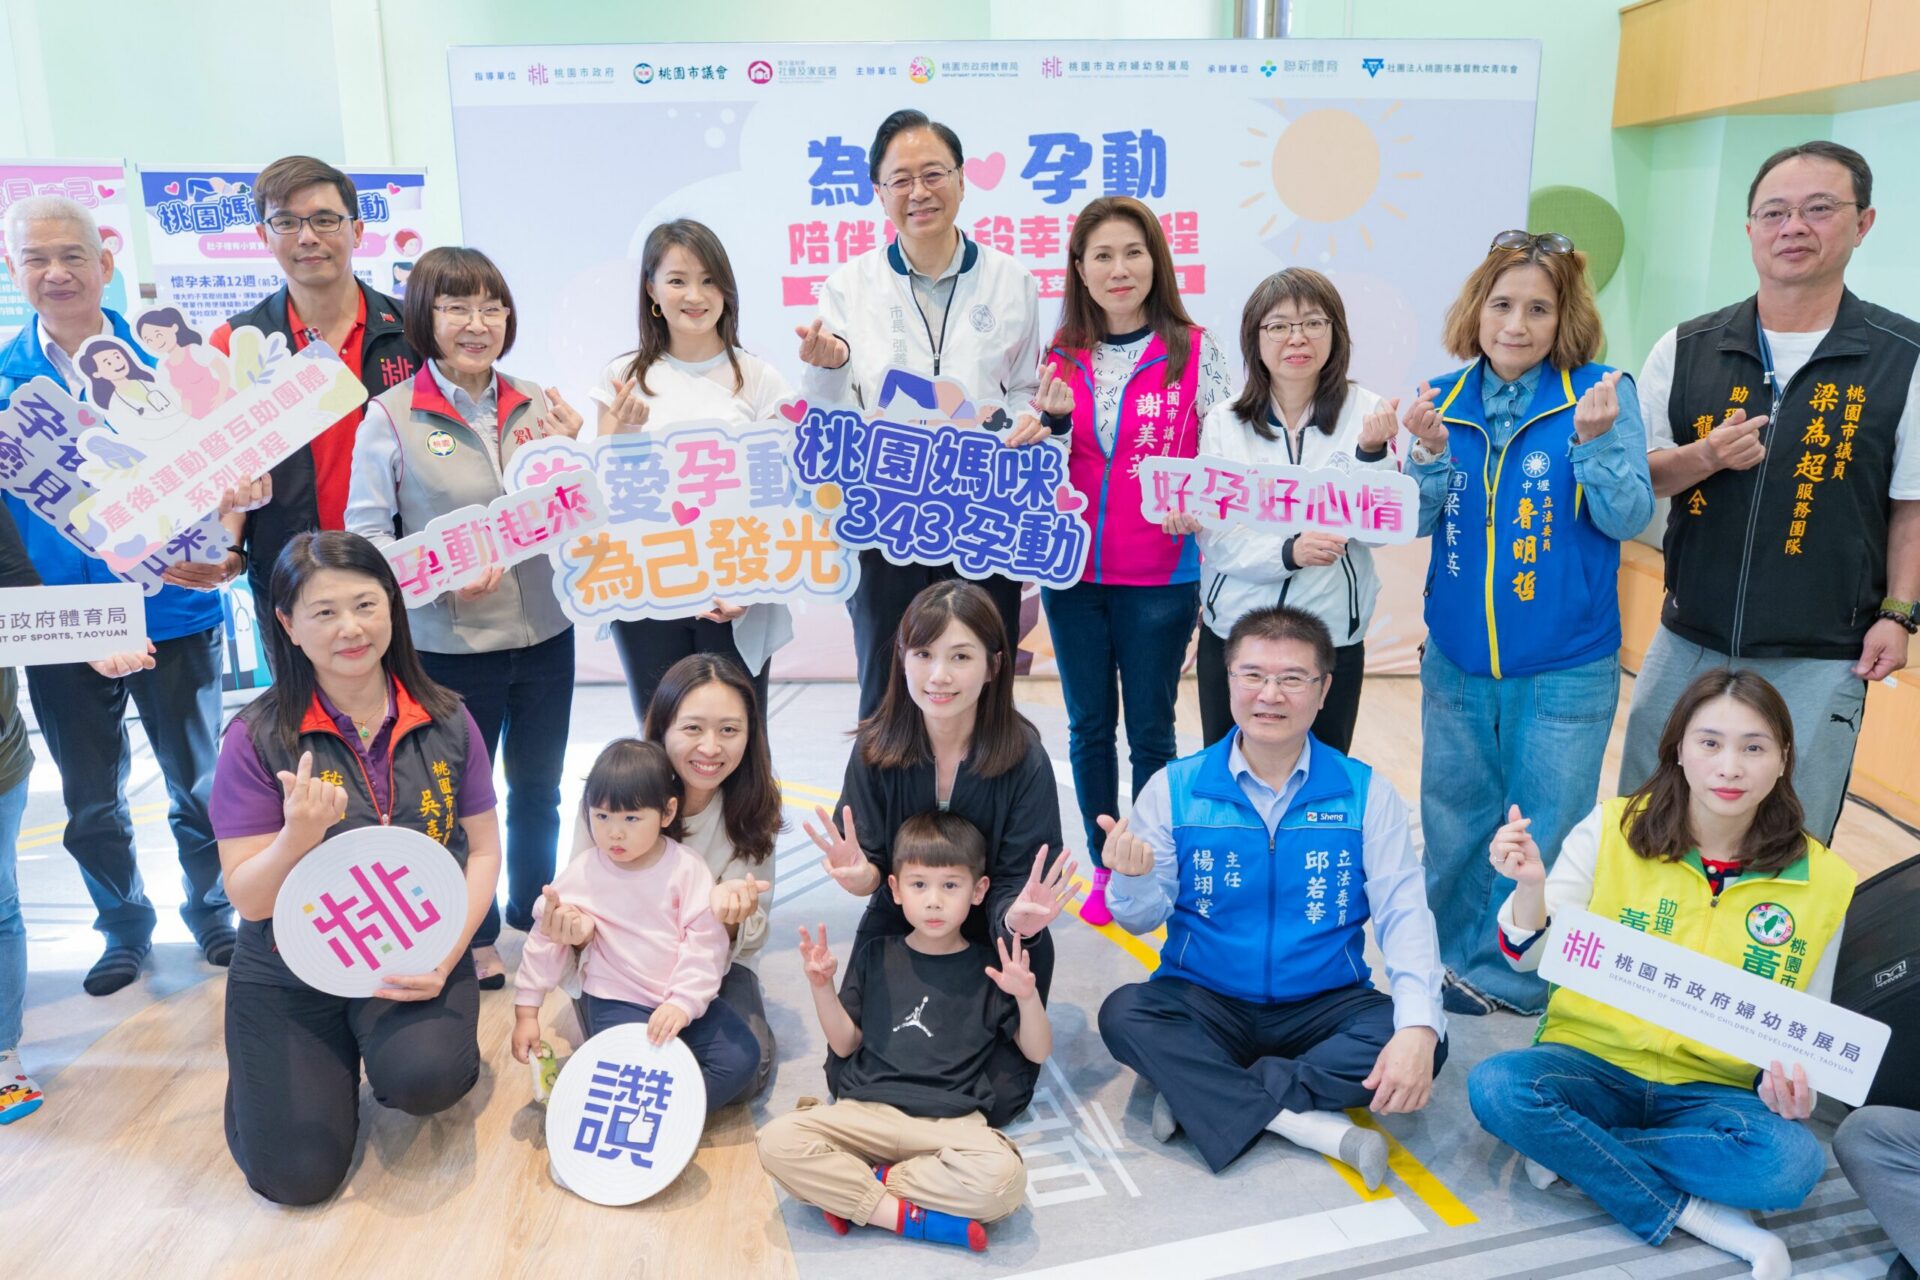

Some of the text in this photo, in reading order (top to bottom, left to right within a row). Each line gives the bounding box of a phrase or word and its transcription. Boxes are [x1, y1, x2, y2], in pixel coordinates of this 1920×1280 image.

[554, 67, 615, 79] 桃園市政府
[657, 64, 729, 81] 桃園市議會
[941, 61, 1019, 72] 桃園市政府體育局
[1068, 60, 1190, 72] 桃園市政府婦幼發展局
[1020, 128, 1168, 205] 孕動
[802, 415, 1064, 510] 桃園媽咪
[1830, 384, 1867, 481] 桃園市議員
[184, 430, 291, 513] 系列課程
[1152, 464, 1404, 532] 好孕好心情
[390, 481, 598, 597] 孕動起來
[568, 512, 842, 607] 為己發光
[843, 487, 1082, 580] 343孕動
[1511, 497, 1539, 602] 魯明哲
[1541, 495, 1554, 552] 立法委員
[12, 634, 27, 642] OF
[30, 632, 73, 641] SPORTS,
[77, 629, 128, 639] TAOYUAN
[1320, 812, 1345, 822] Sheng
[1224, 851, 1243, 888] 主任
[1304, 850, 1330, 925] 邱若華
[1335, 849, 1353, 927] 立法委員
[1653, 897, 1679, 936] 助理
[1608, 972, 1656, 994] DEPARTMENT
[1670, 997, 1698, 1012] WOMEN
[1818, 1055, 1855, 1075] TAOYUAN
[1614, 951, 1862, 1064] 桃園市政府婦幼發展局
